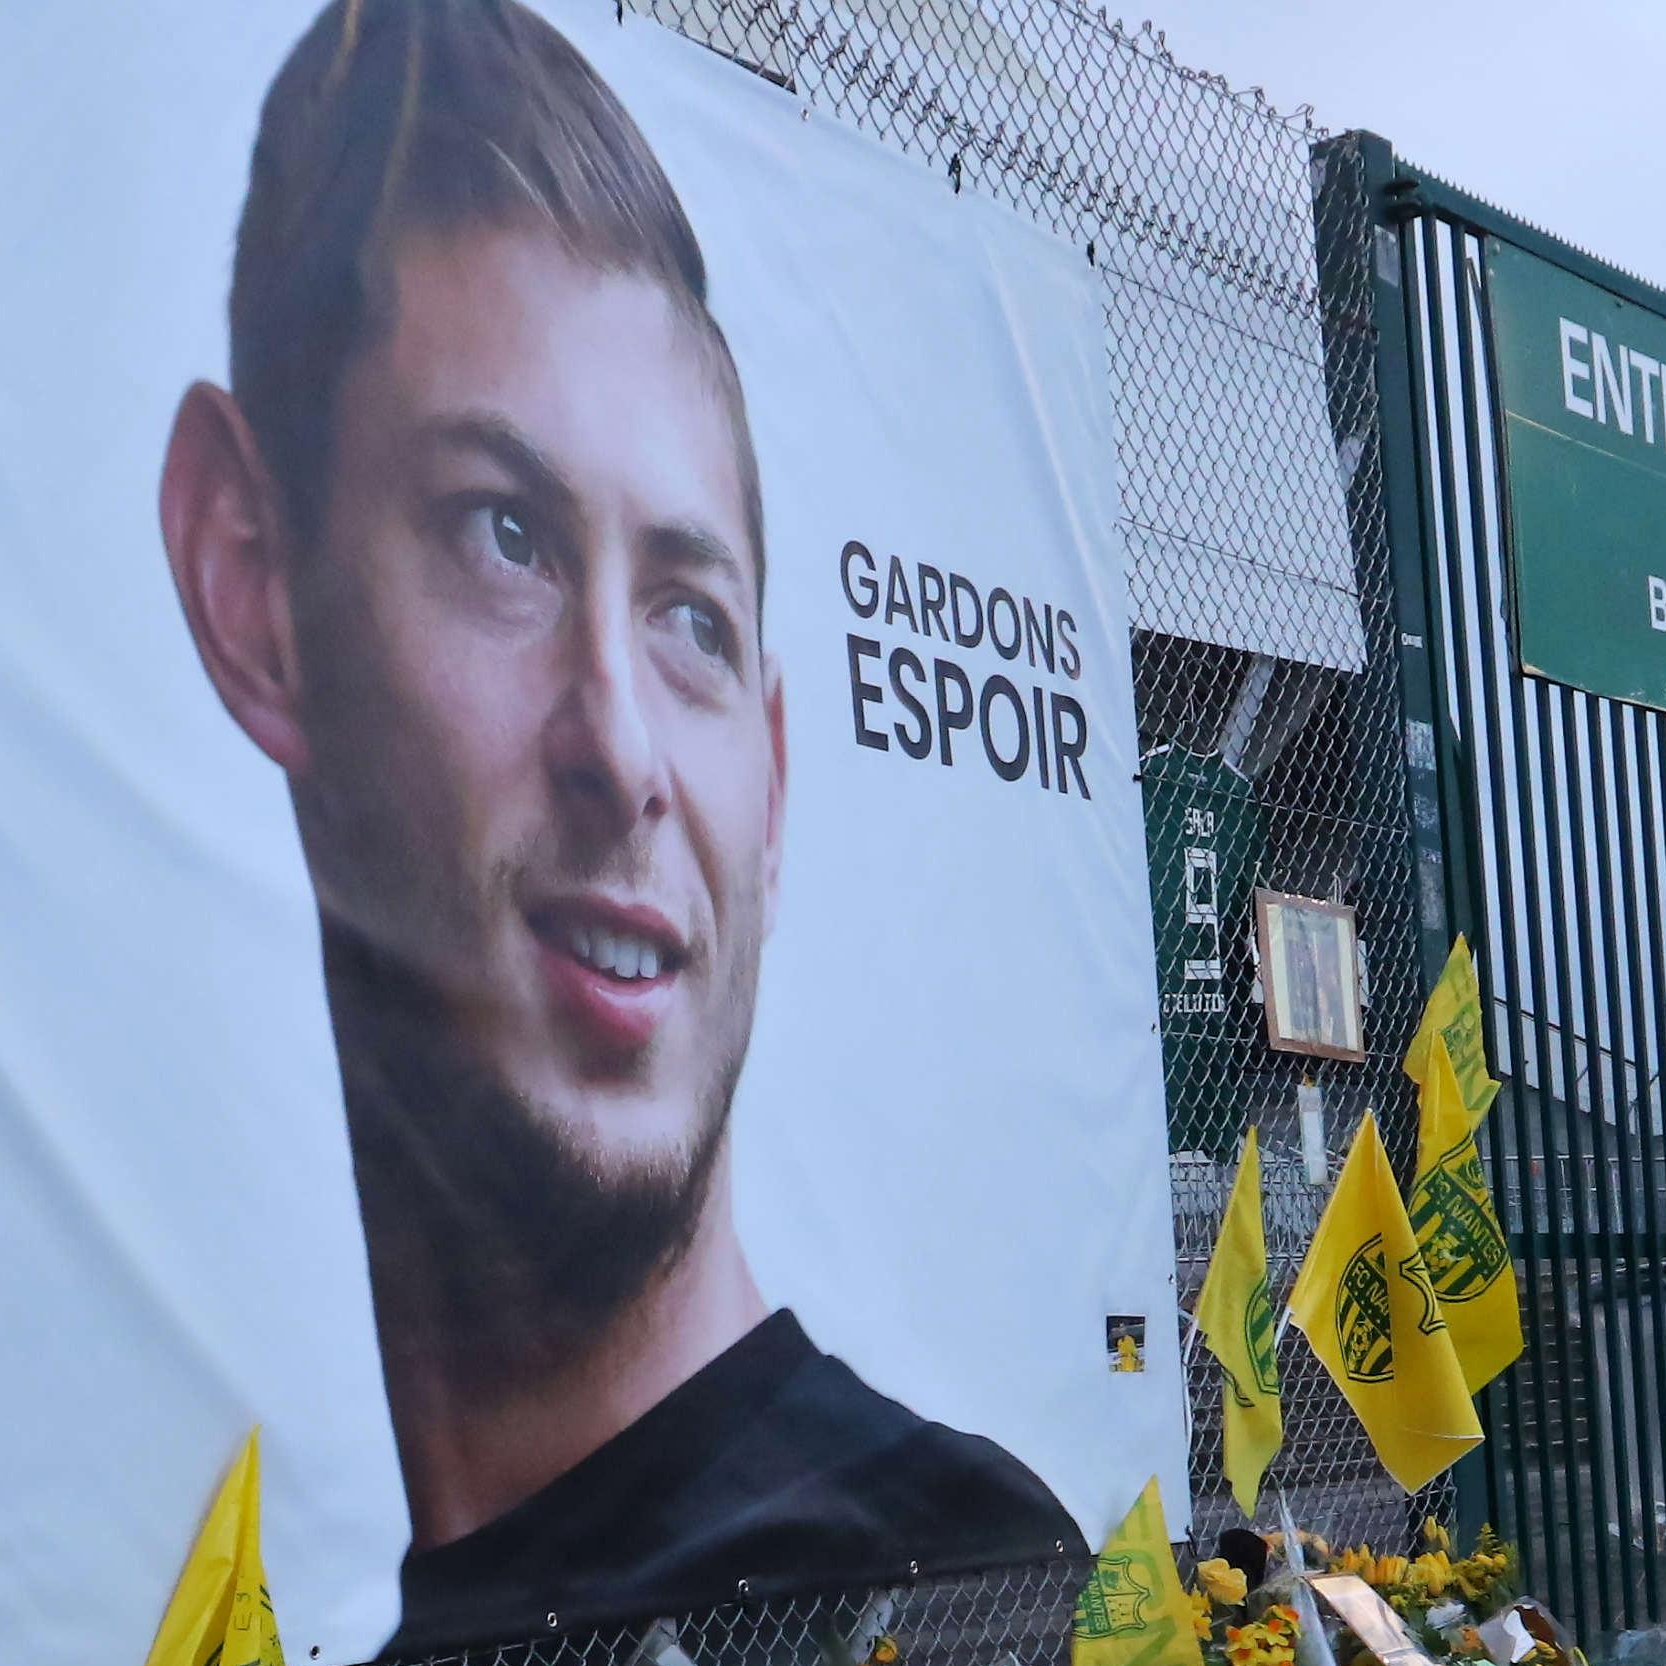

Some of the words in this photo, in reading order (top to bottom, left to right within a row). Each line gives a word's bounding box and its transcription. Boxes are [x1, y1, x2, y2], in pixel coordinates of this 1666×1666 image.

[839, 540, 1082, 681] GARDONS
[845, 632, 1093, 802] ESPOIR
[1184, 847, 1222, 981] 9
[1351, 1261, 1371, 1289] FC
[1087, 1580, 1110, 1633] NANTES
